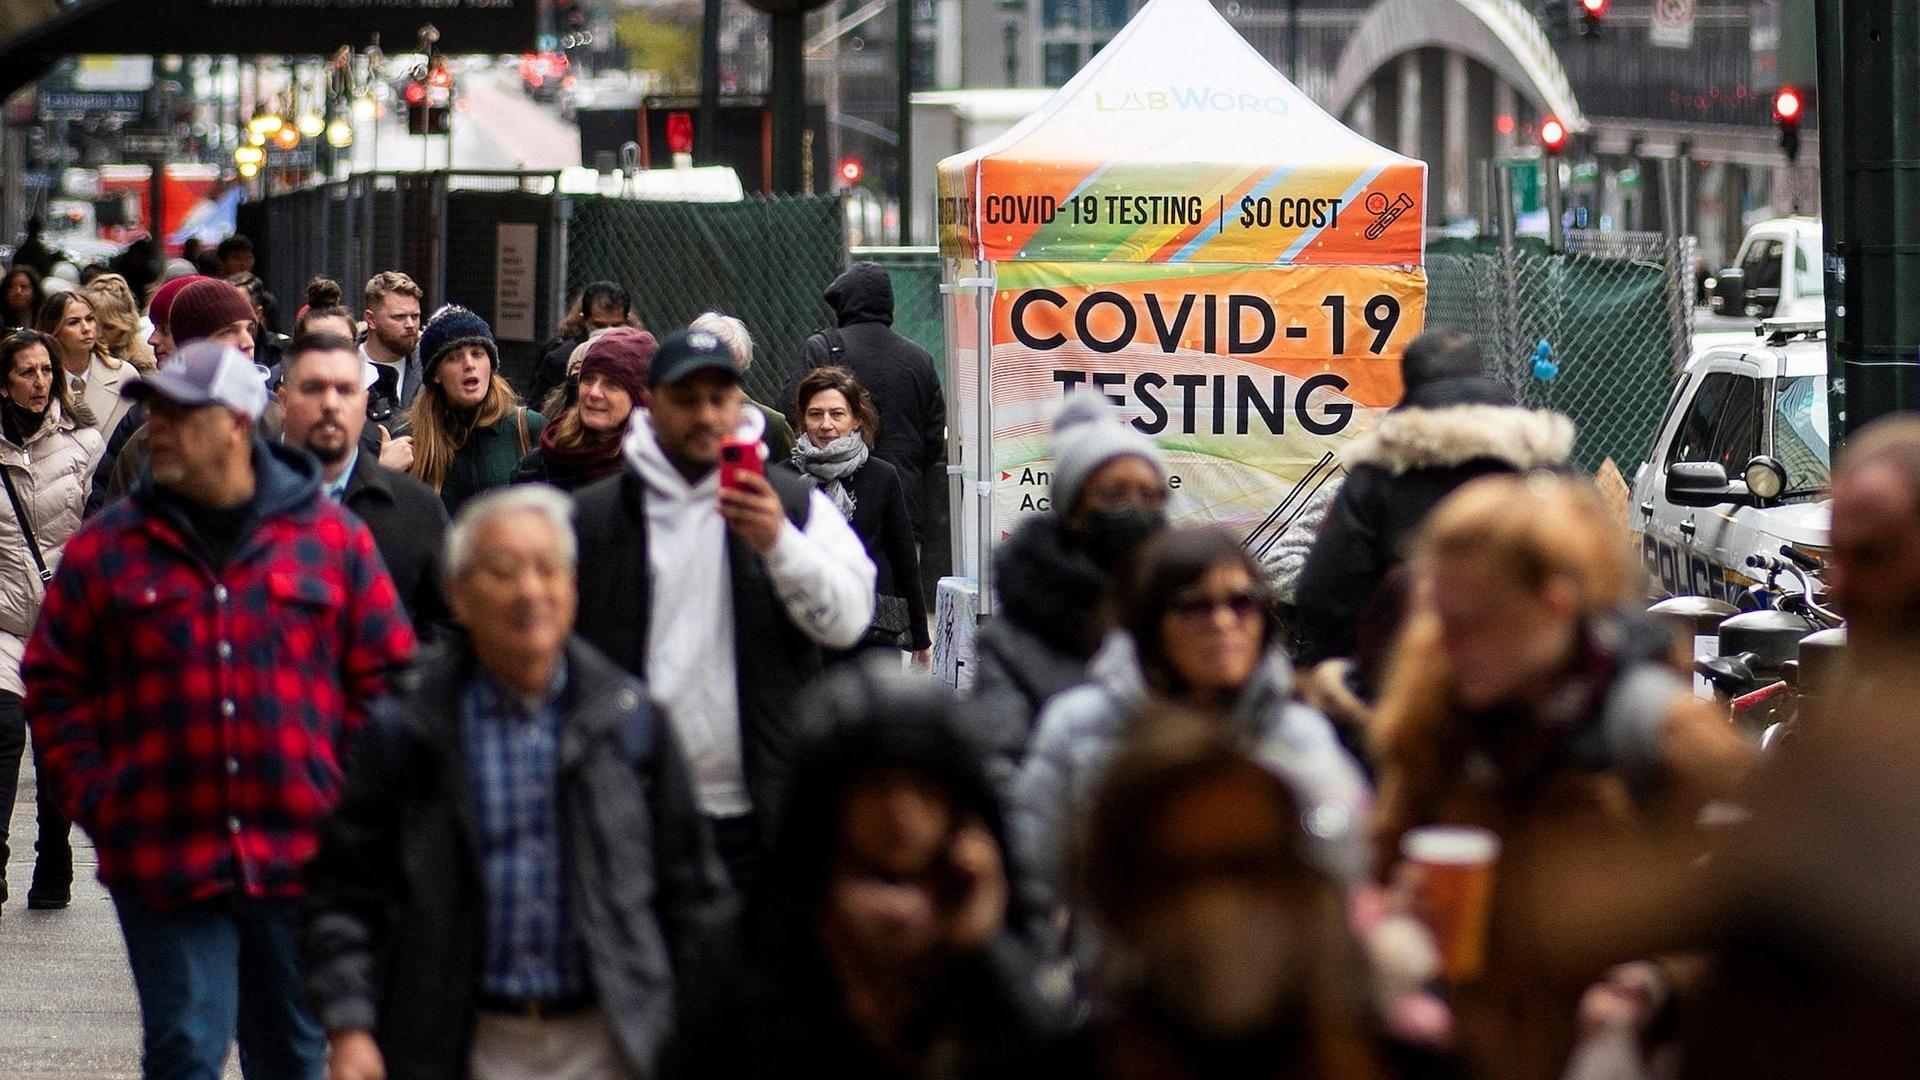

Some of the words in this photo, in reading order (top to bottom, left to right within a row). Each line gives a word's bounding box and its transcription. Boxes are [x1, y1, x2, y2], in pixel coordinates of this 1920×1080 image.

[986, 194, 1098, 225] COVID-19
[1104, 195, 1202, 225] TESTING
[1240, 195, 1272, 228] $0
[1279, 197, 1343, 228] COST
[1010, 288, 1400, 355] COVID-19
